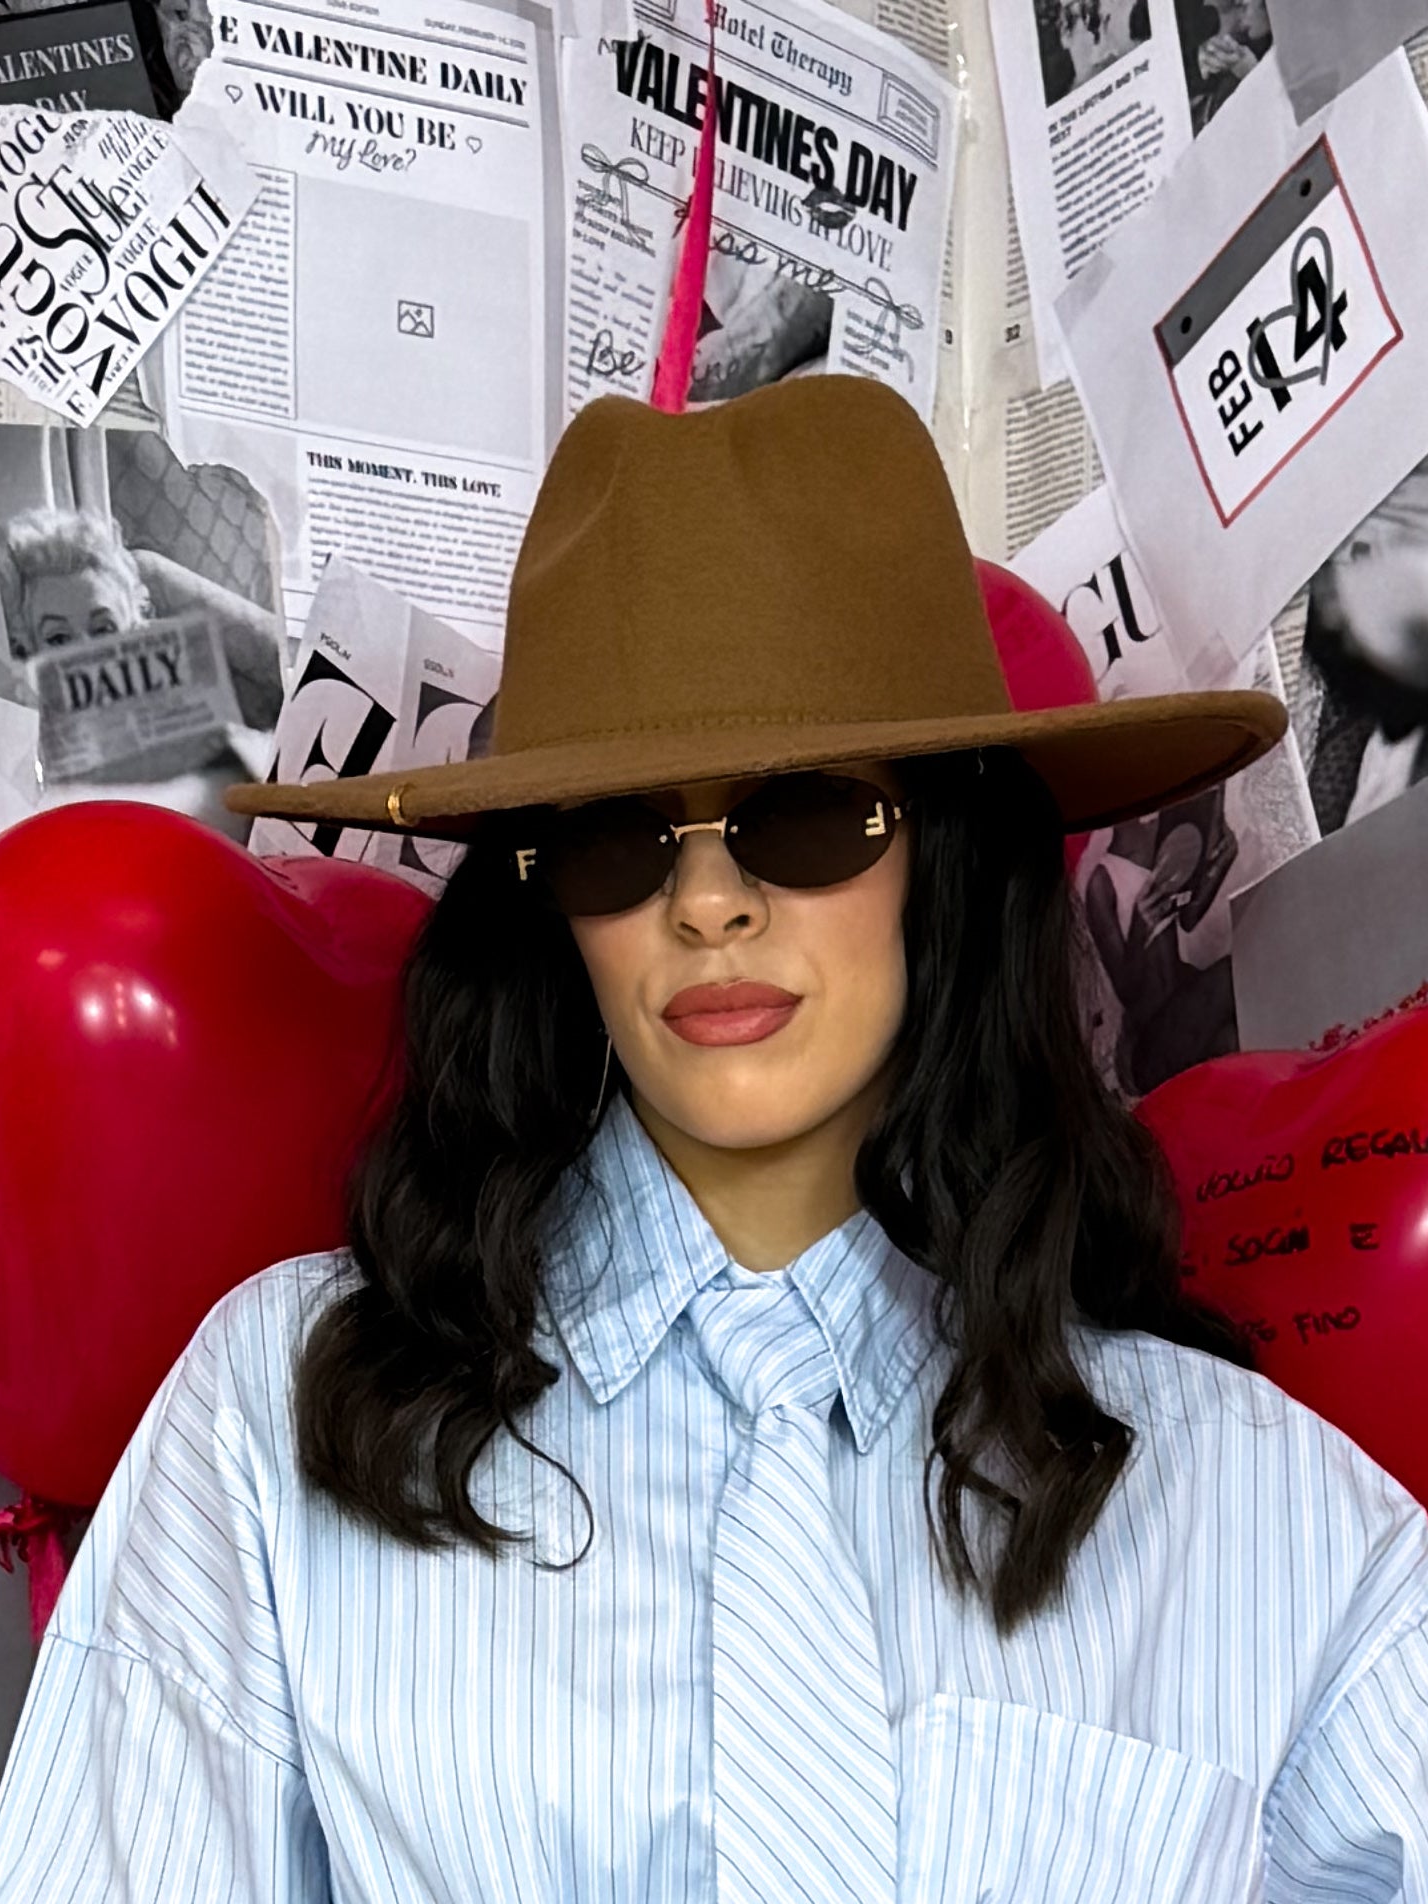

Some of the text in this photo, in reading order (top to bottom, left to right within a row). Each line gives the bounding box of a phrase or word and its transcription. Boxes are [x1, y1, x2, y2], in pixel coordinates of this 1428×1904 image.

[251, 21, 528, 105] VALENTINE DAILY
[770, 28, 854, 97] Therapy
[254, 82, 457, 151] WILL YOU BE
[629, 116, 894, 273] KEEP LOVE
[843, 141, 917, 232] DAY
[1250, 255, 1350, 413] 14
[1208, 349, 1264, 456] FEB
[462, 480, 501, 498] LOVE
[65, 647, 186, 712] DAILY
